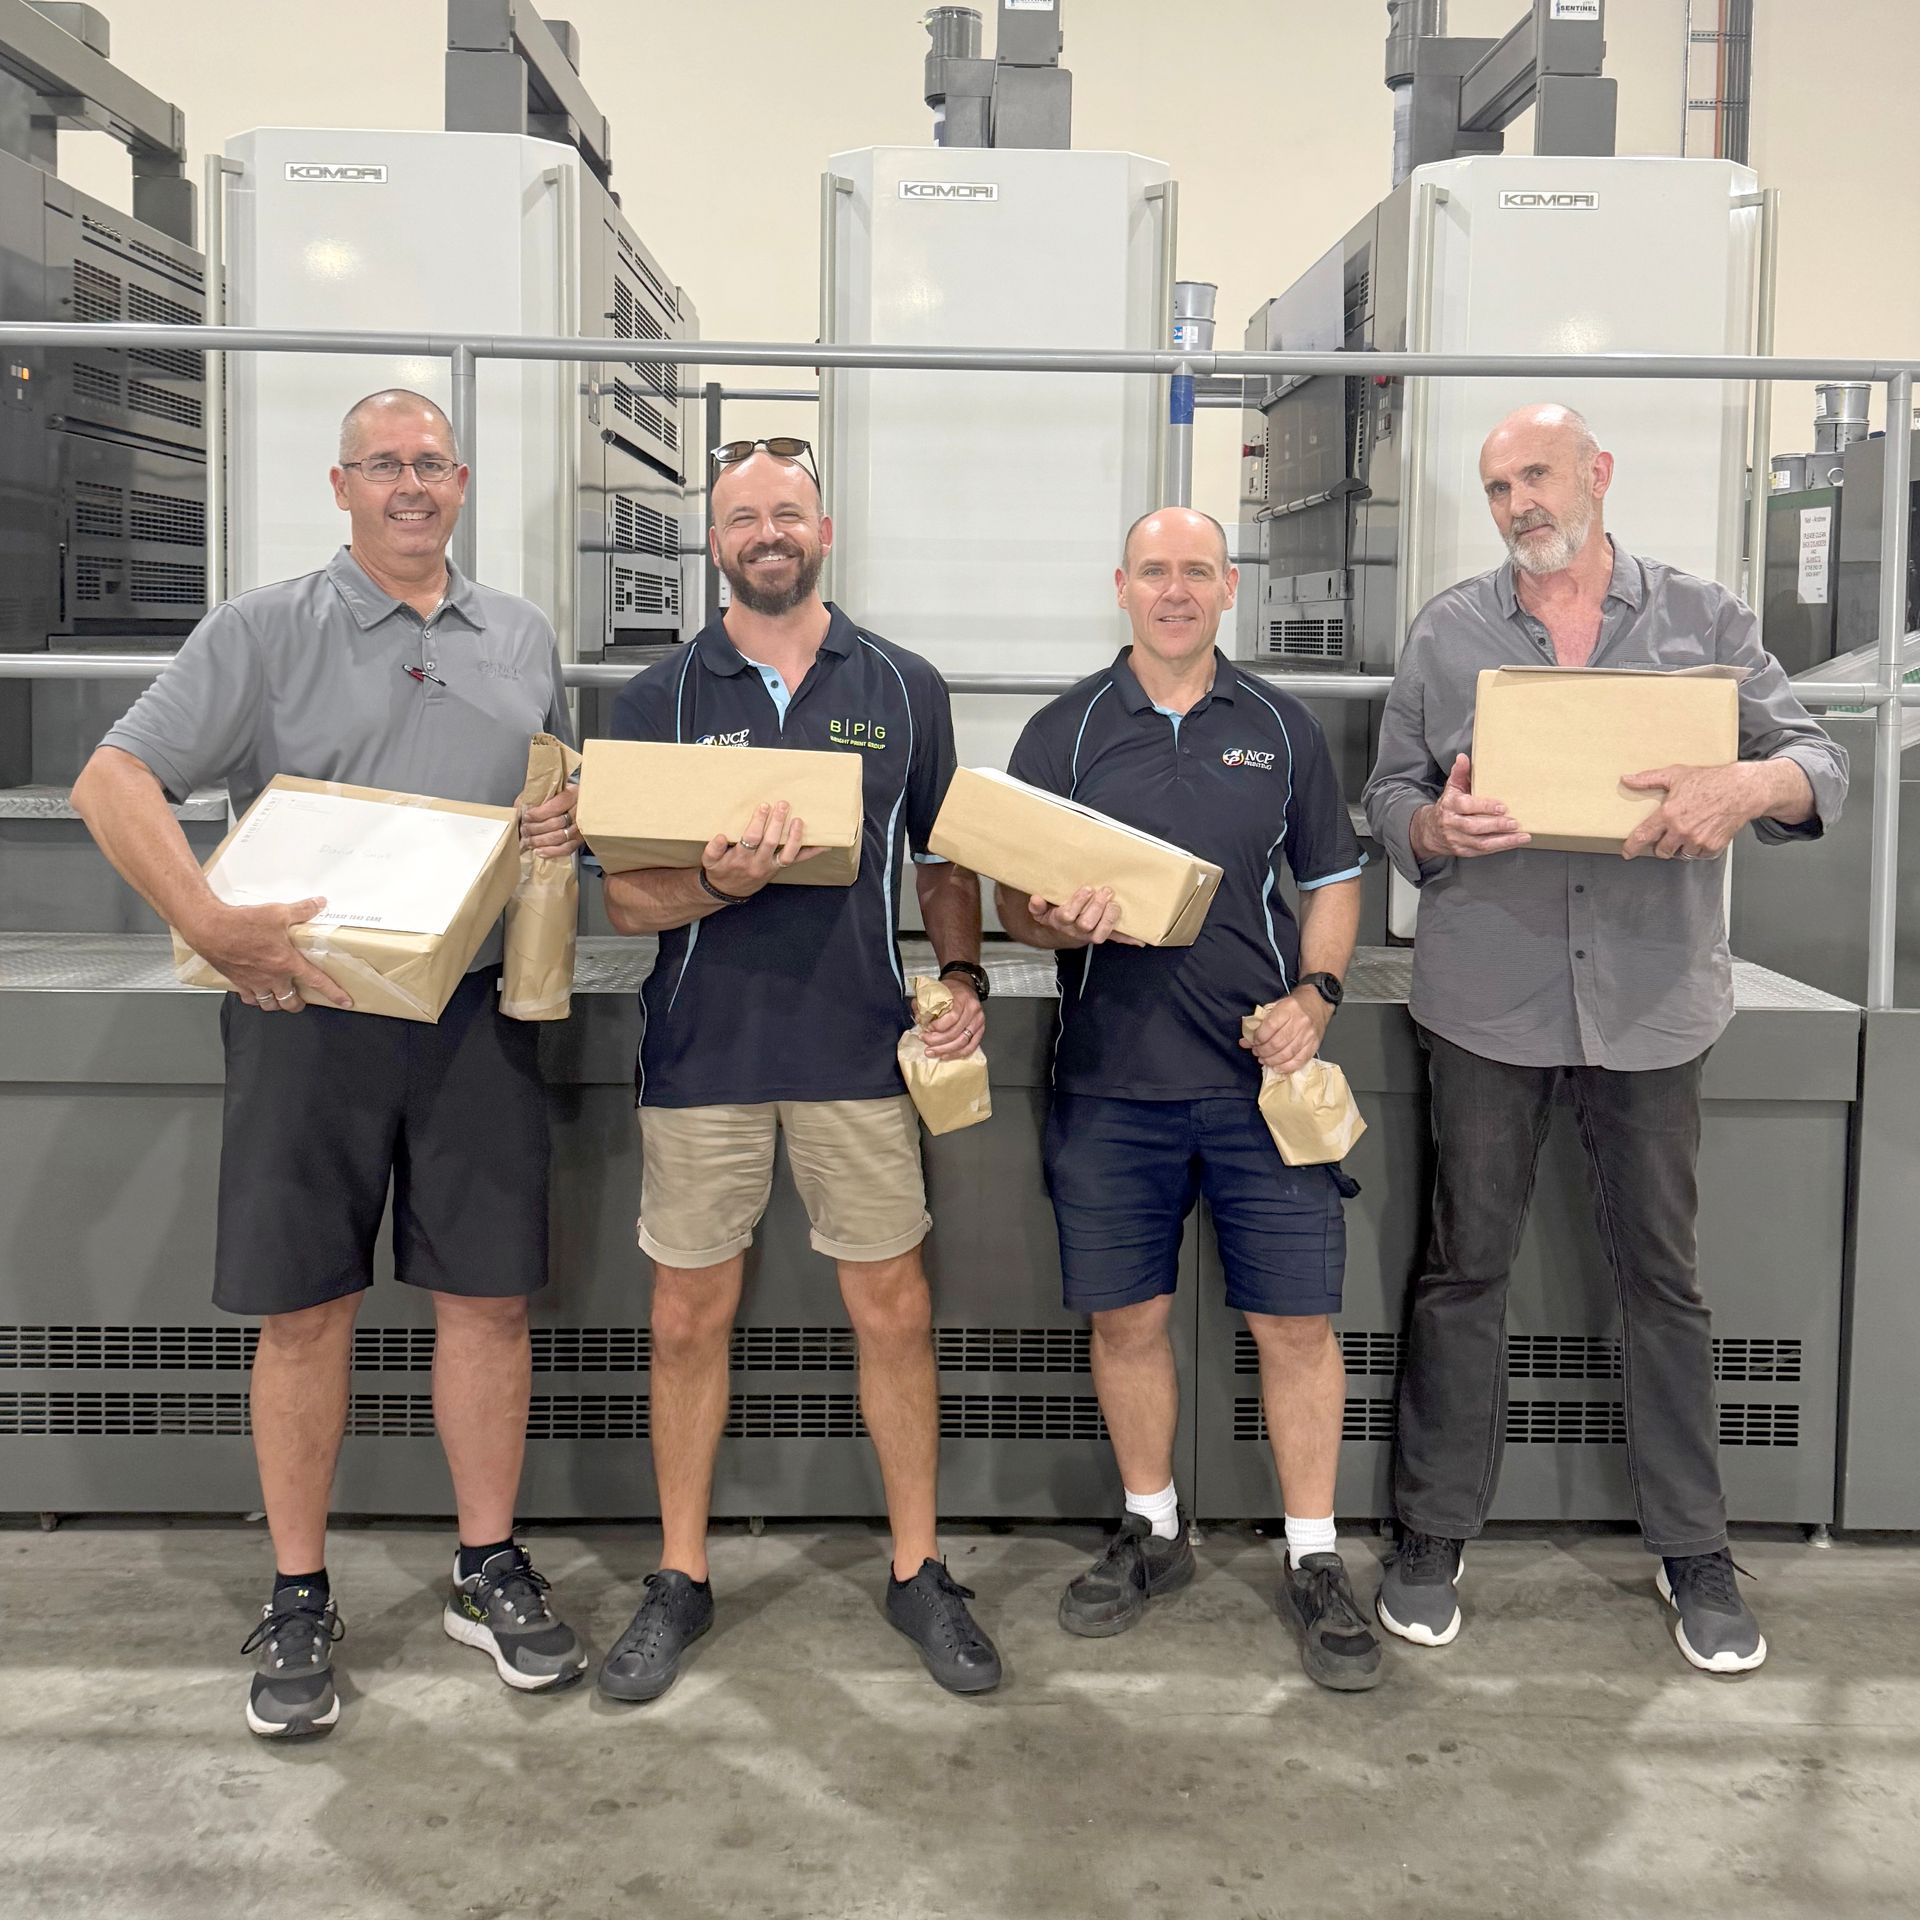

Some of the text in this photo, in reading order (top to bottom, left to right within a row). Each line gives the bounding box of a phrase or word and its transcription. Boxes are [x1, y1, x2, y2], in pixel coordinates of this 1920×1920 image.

[290, 166, 382, 180] KOMORI
[904, 184, 993, 198] KOMORI
[1504, 194, 1594, 207] KOMORI
[718, 728, 750, 746] NCP
[1245, 749, 1275, 765] NCP
